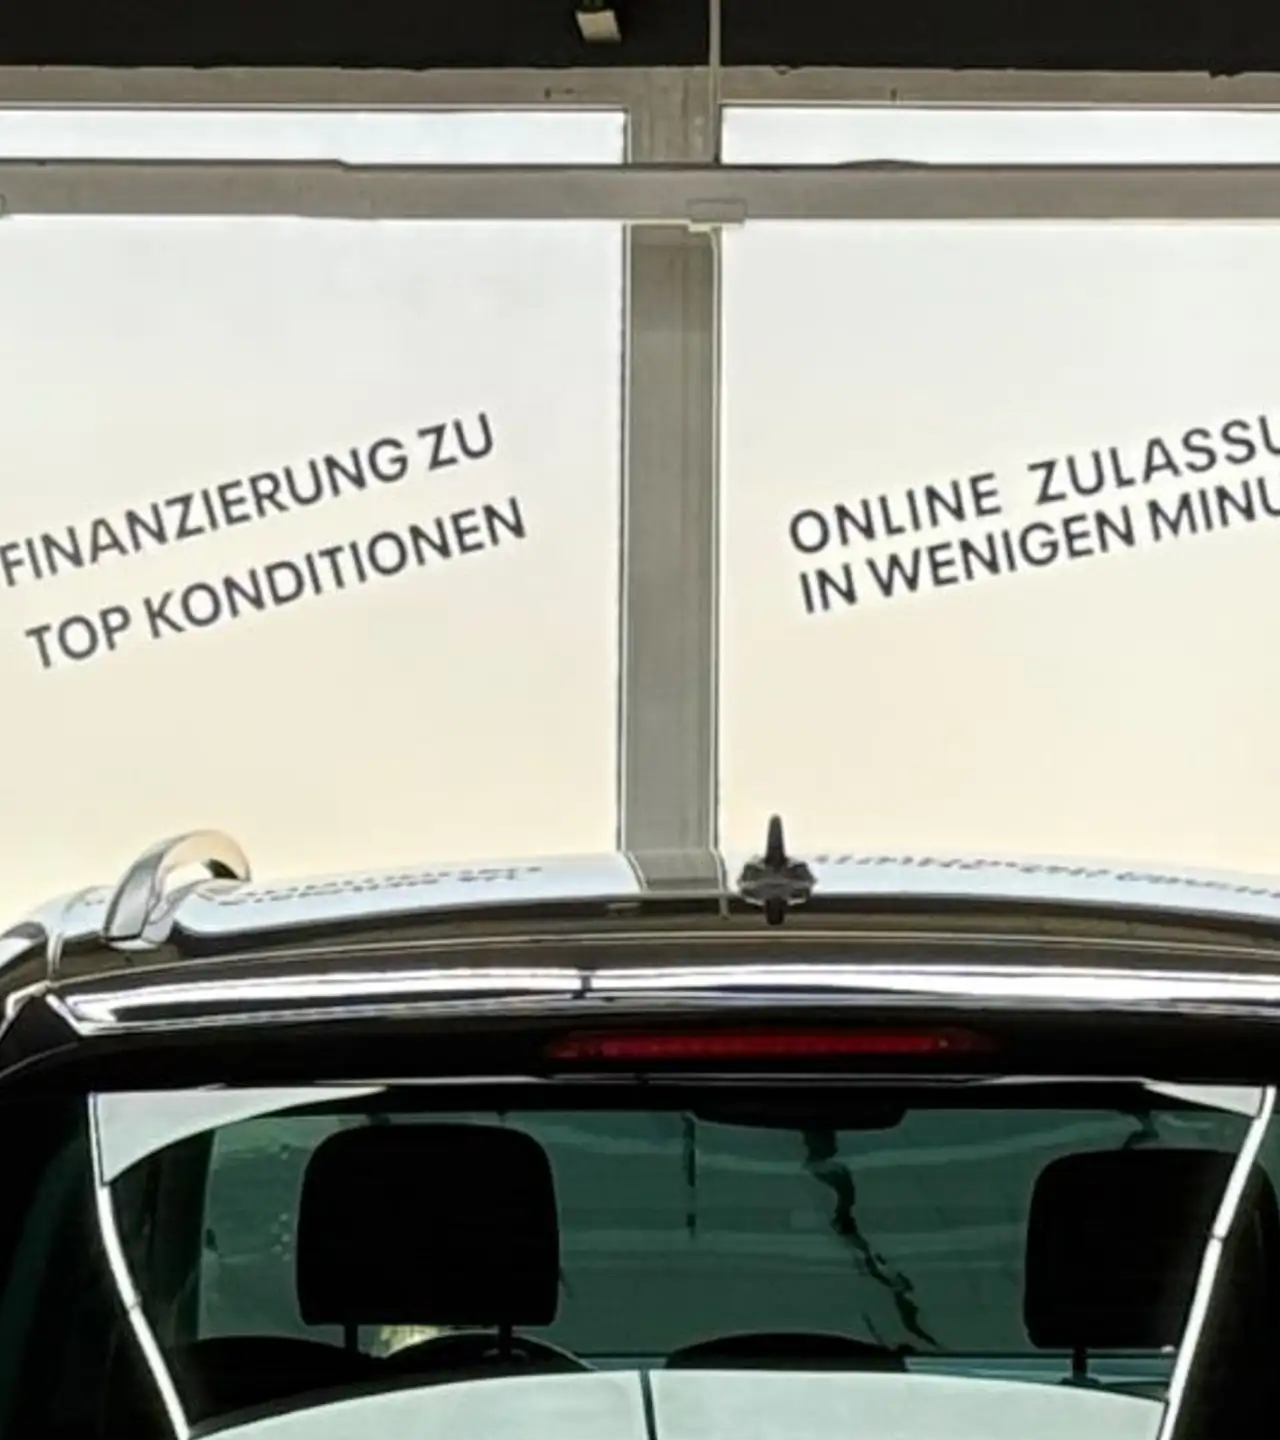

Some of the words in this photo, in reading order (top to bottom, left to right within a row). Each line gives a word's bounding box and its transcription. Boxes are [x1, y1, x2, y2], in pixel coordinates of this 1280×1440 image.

[416, 411, 495, 472] ZU
[788, 472, 1002, 554] ONLINE
[799, 562, 858, 615] IN
[865, 505, 1136, 599] WENIGEN
[24, 604, 132, 669] TOP
[142, 496, 527, 640] KONDITIONEN
